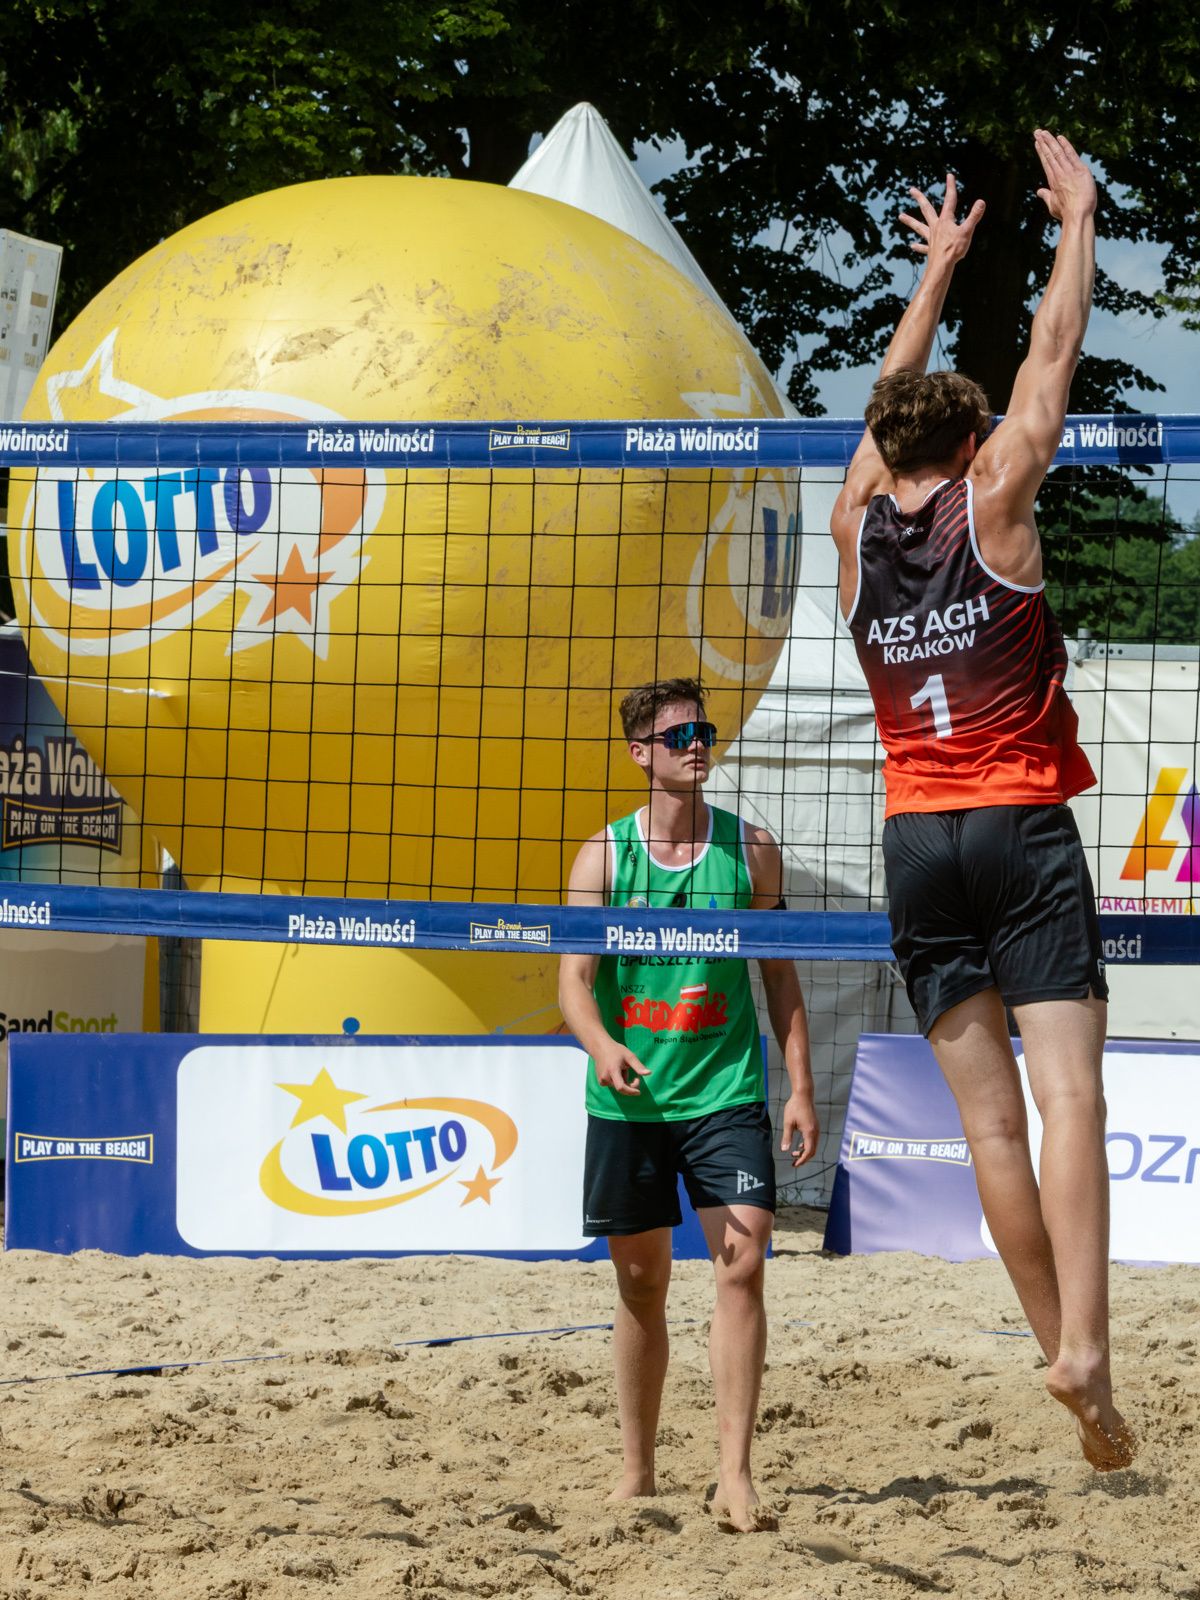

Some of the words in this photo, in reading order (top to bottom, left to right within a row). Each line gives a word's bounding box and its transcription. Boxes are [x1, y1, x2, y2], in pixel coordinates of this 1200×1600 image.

[0, 427, 69, 452] Wolności
[306, 427, 355, 453] Plaża
[358, 428, 435, 453] Wolności
[493, 434, 513, 447] PLAY
[513, 435, 525, 446] ON
[526, 436, 540, 445] THE
[541, 434, 566, 447] BEACH
[625, 427, 676, 452] Plaża
[680, 426, 759, 451] Wolności
[1079, 421, 1163, 448] Wolności
[57, 467, 272, 590] LOTTO
[866, 614, 916, 645] AZS
[922, 595, 990, 638] AGH
[883, 629, 976, 665] KRAKÓW
[909, 673, 952, 739] 1
[10, 810, 37, 837] PLAY
[40, 815, 55, 834] ON
[59, 815, 78, 834] THE
[82, 813, 116, 839] BEACH
[0, 899, 50, 925] lności
[1100, 896, 1196, 914] AKADEMIA
[288, 914, 335, 939] Plaża
[339, 916, 416, 942] Wolności
[474, 927, 493, 939] PLAY
[494, 930, 505, 939] ON
[507, 930, 520, 940] THE
[522, 929, 546, 941] BEACH
[606, 925, 656, 950] Plaża
[660, 926, 739, 952] Wolności
[1102, 934, 1142, 959] ości
[621, 985, 646, 994] NSZZ
[22, 1139, 53, 1157] PLAY
[56, 1142, 74, 1155] ON
[79, 1142, 102, 1155] THE
[105, 1141, 146, 1157] BEACH
[310, 1119, 468, 1191] LOTTO
[856, 1138, 885, 1155] PLAY
[887, 1142, 904, 1154] ON
[907, 1144, 927, 1156] THE
[930, 1143, 967, 1160] BEACH
